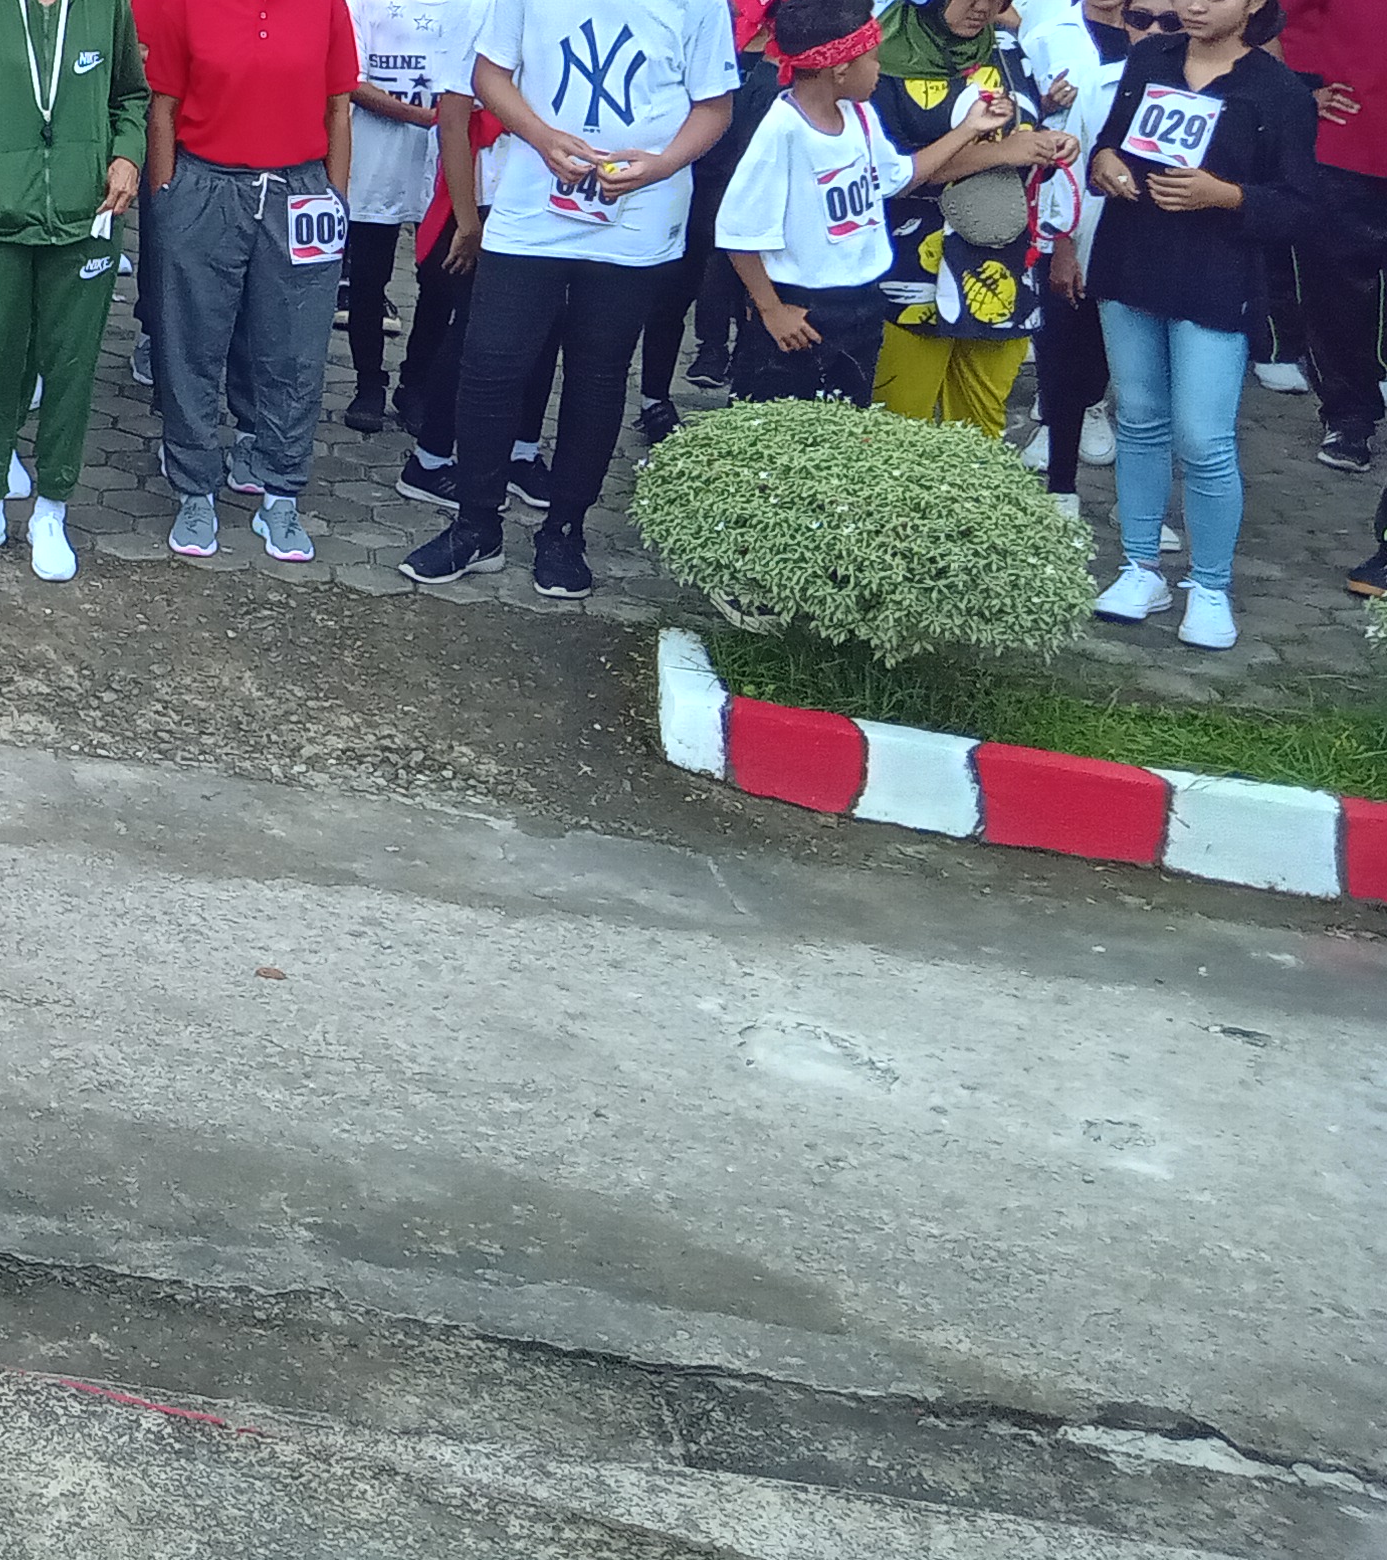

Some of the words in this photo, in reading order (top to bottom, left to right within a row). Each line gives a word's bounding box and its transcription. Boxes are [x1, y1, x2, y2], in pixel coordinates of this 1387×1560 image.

[79, 51, 101, 65] NIKE
[368, 53, 427, 70] SHINE
[1138, 104, 1208, 150] 029
[826, 175, 874, 222] 002
[295, 212, 346, 245] 005
[86, 256, 111, 271] NIKE
